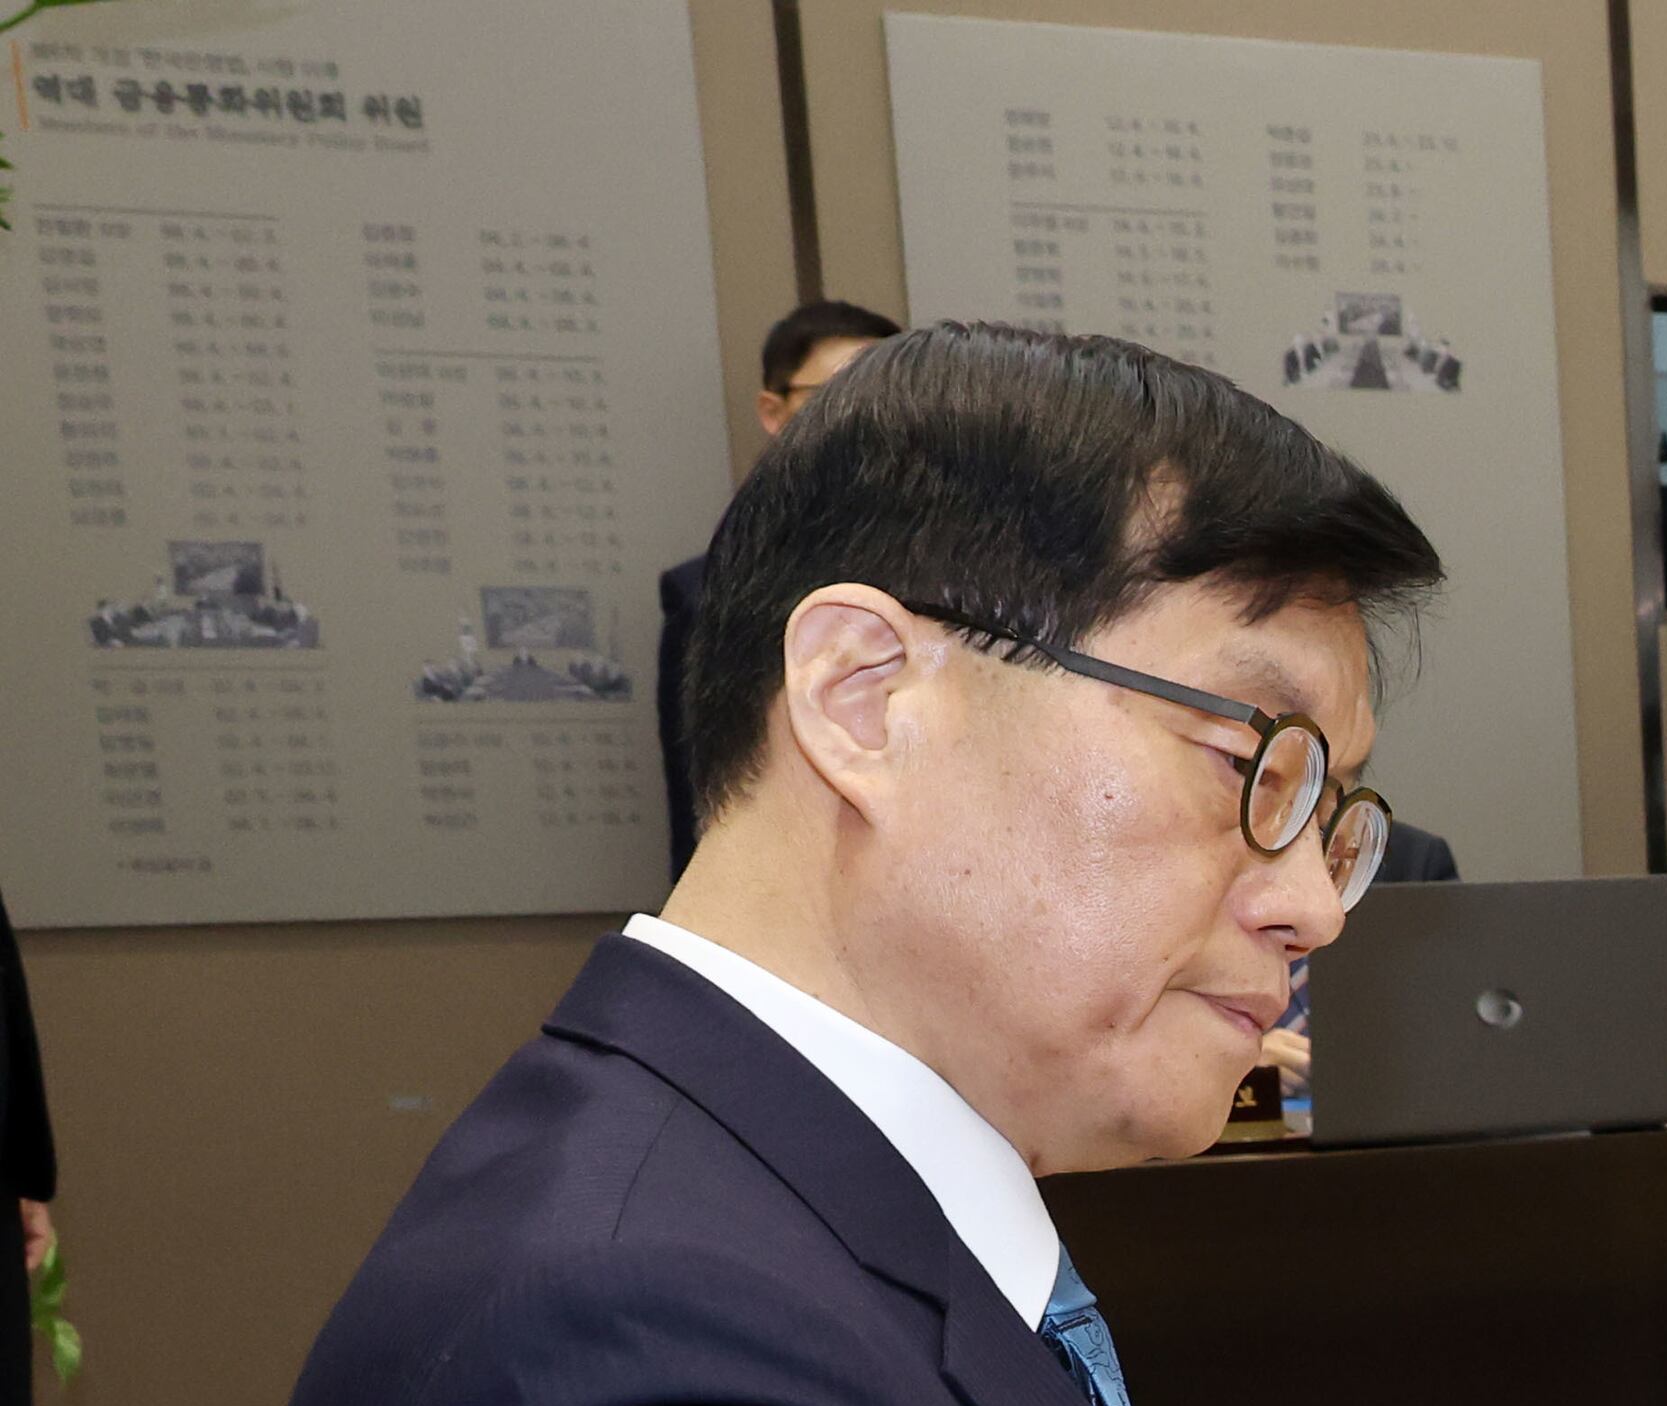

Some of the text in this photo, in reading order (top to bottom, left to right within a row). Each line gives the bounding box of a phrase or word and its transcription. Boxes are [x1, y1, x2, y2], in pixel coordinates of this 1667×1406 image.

[33, 73, 424, 129] 역대 금융통화위원회 위원
